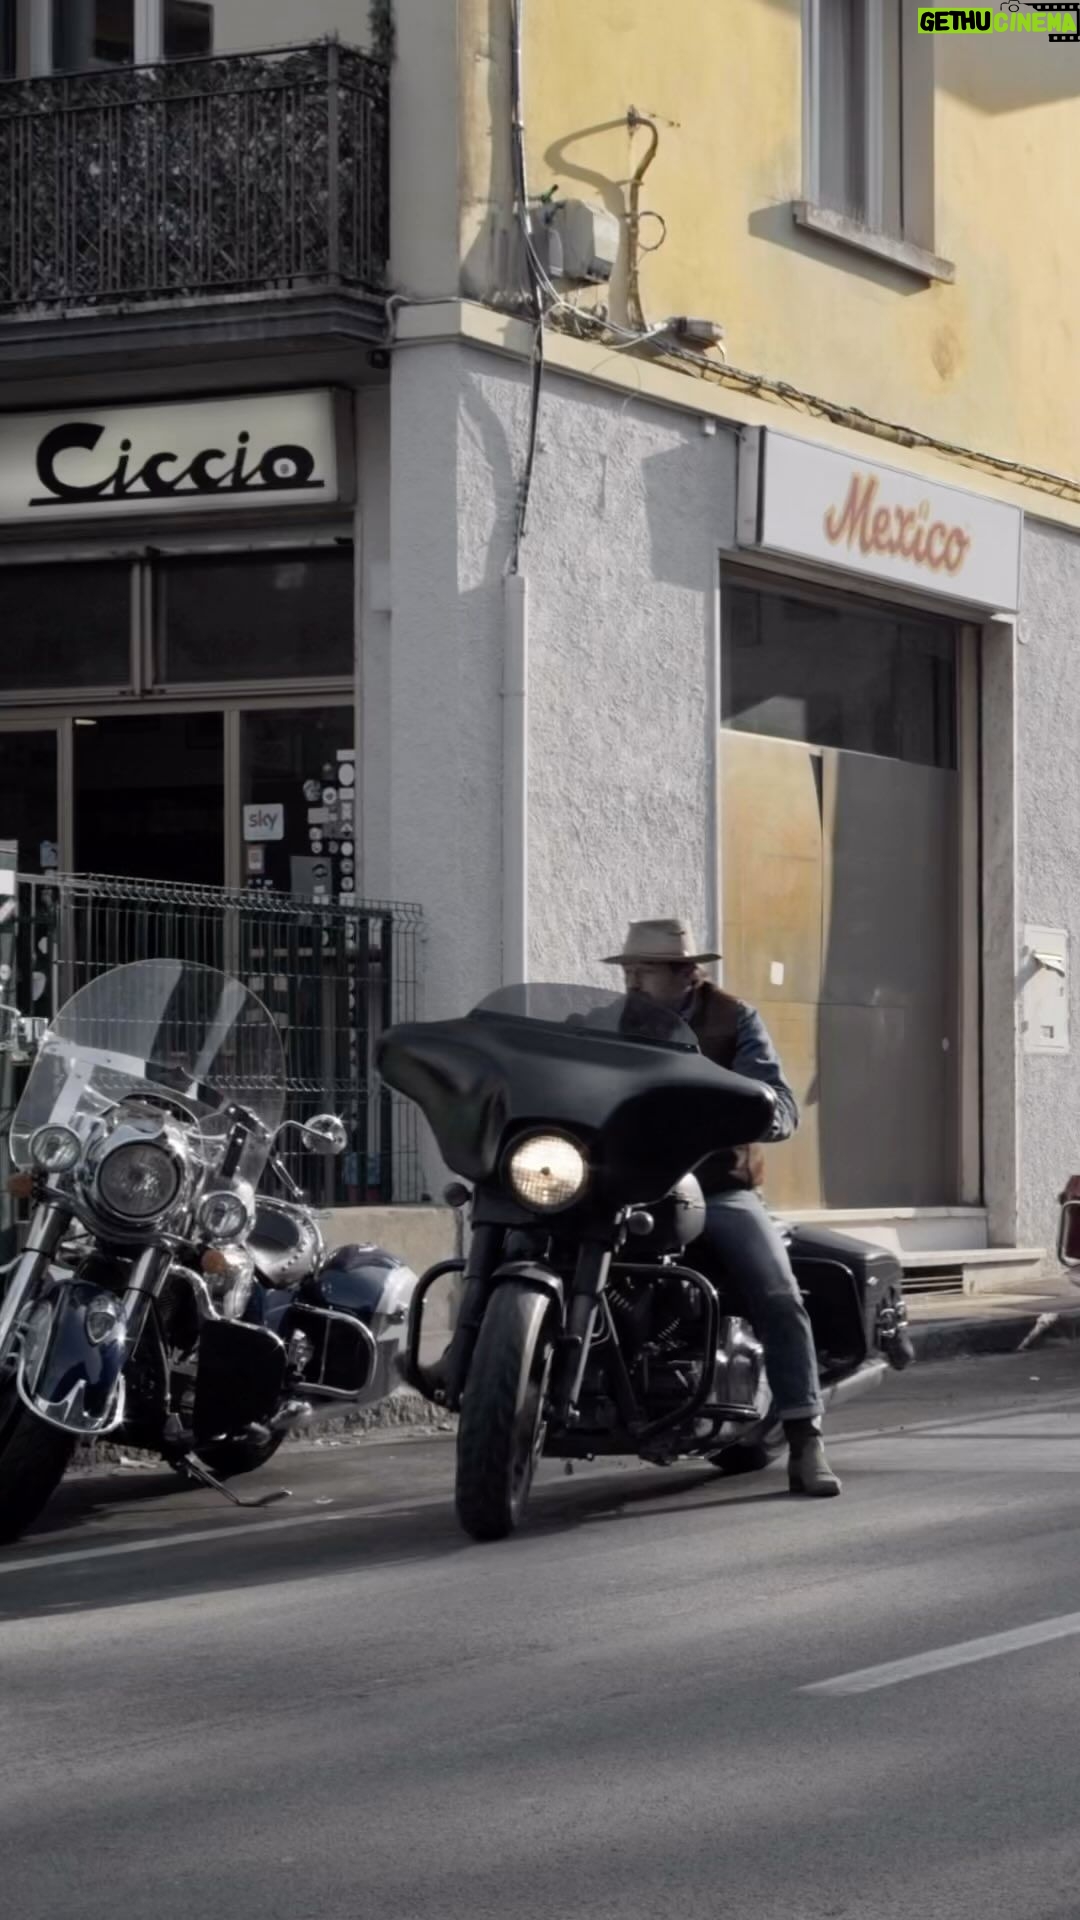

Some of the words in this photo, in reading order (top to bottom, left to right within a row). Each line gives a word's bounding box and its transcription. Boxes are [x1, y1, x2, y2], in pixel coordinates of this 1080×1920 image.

[34, 422, 316, 500] Ciccio
[824, 472, 971, 574] Mexico
[248, 809, 279, 831] sky
